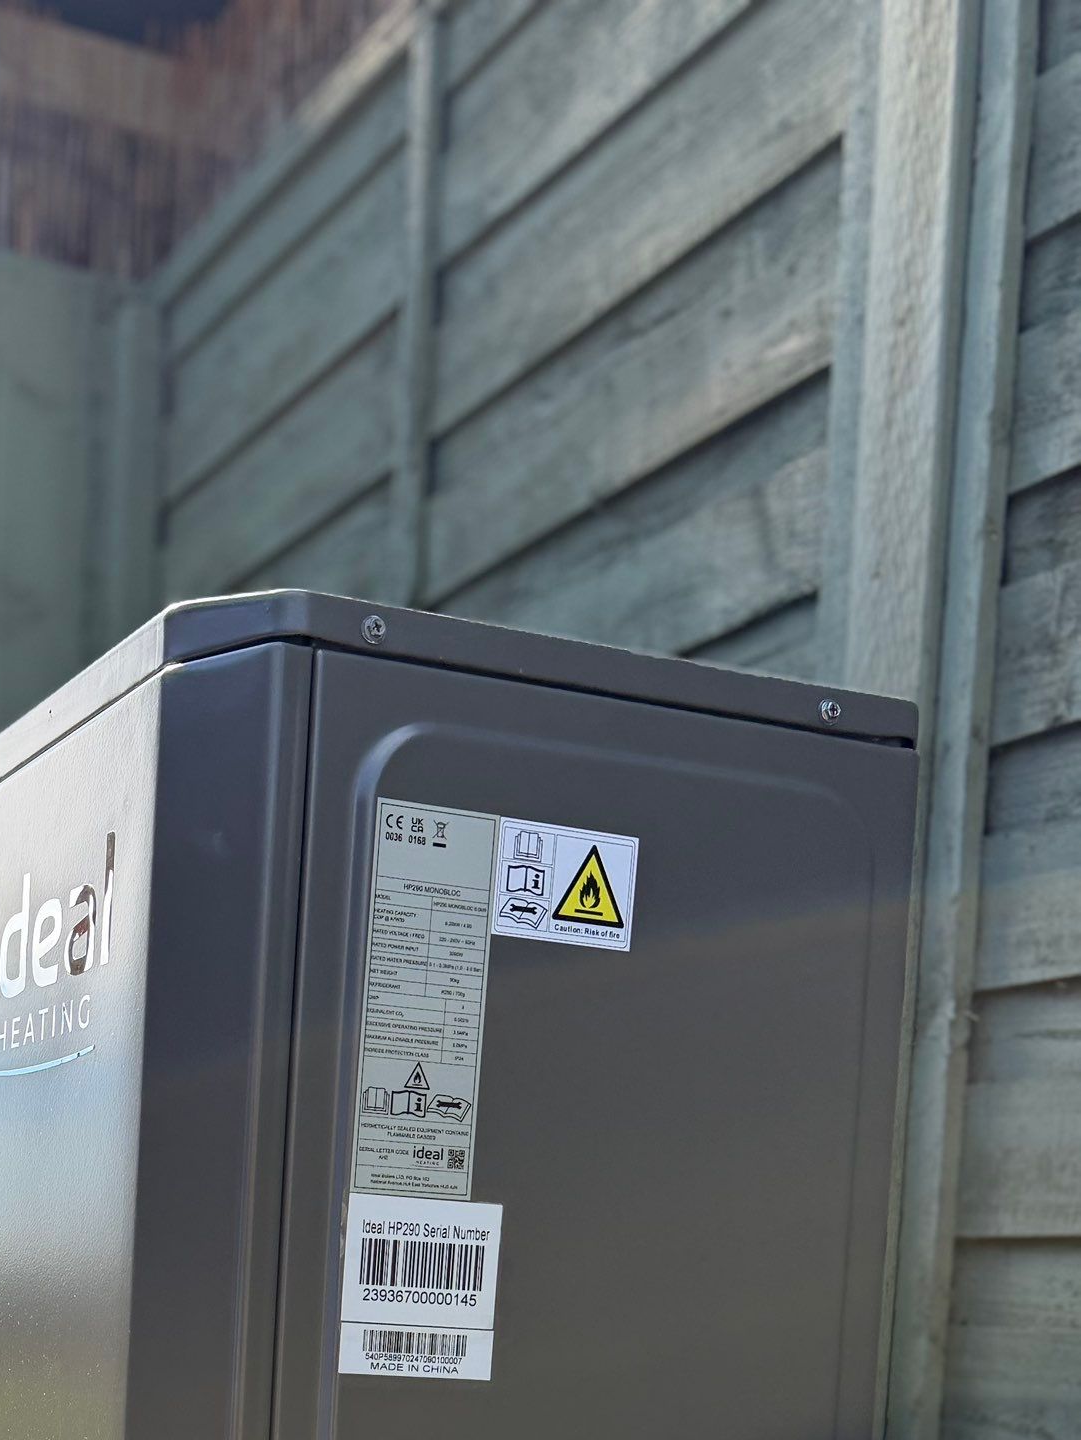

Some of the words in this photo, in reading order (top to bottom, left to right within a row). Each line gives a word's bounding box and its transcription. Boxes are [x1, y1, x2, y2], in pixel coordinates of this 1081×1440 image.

[386, 814, 404, 830] CE
[424, 885, 460, 896] MONOBLOC
[554, 924, 583, 934] Caution:
[584, 927, 600, 937] Risk
[601, 928, 608, 937] of
[609, 929, 620, 939] fire
[412, 1145, 443, 1160] ideal
[362, 1219, 385, 1235] Ideal
[387, 1222, 420, 1237] HP290
[423, 1224, 451, 1239] Serial
[453, 1226, 490, 1241] Number
[362, 1288, 477, 1307] 23936700000145
[370, 1362, 404, 1372] MADE
[408, 1364, 419, 1373] IN
[422, 1365, 459, 1375] CHINA
